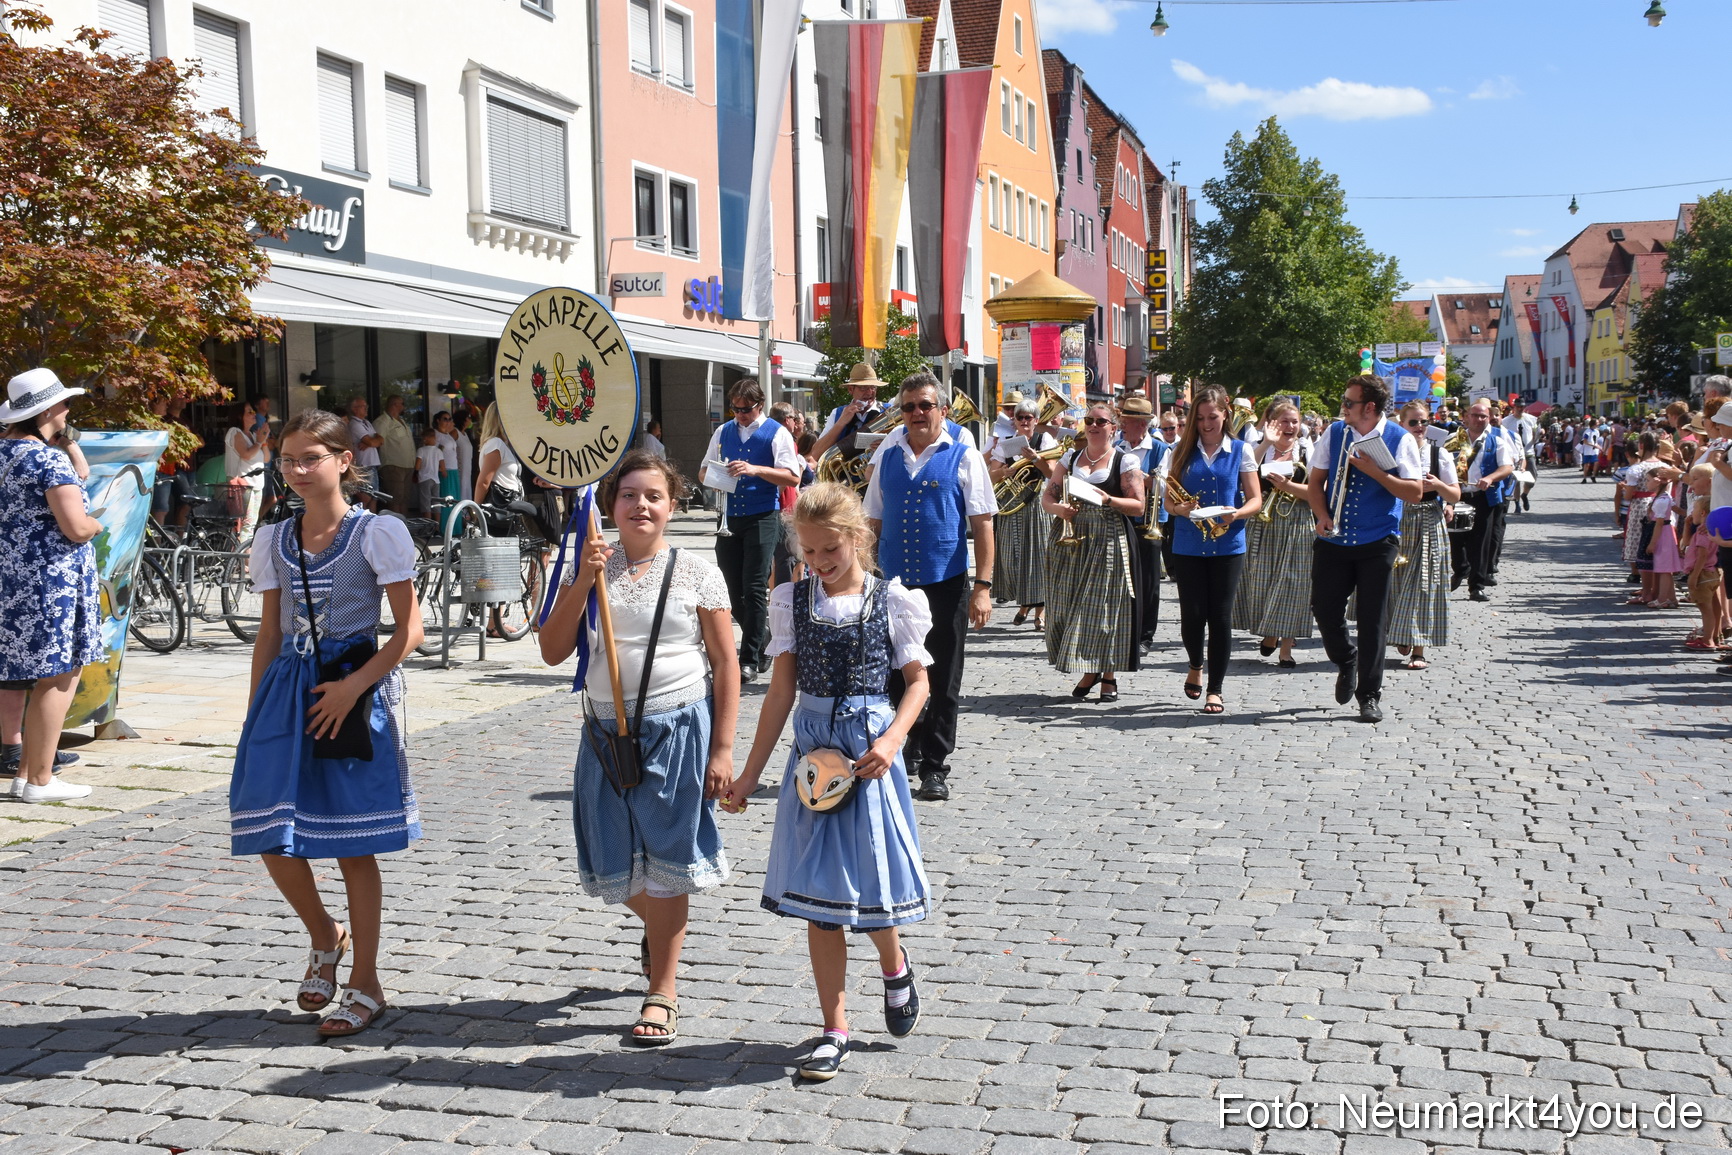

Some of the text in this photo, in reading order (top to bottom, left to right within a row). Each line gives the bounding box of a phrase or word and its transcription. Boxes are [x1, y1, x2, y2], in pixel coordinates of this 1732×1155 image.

[613, 276, 661, 293] sutor.
[685, 275, 724, 315] sut
[1149, 251, 1167, 350] HOTEL
[500, 295, 624, 382] BLASKAPELLE
[528, 425, 619, 479] DEINING
